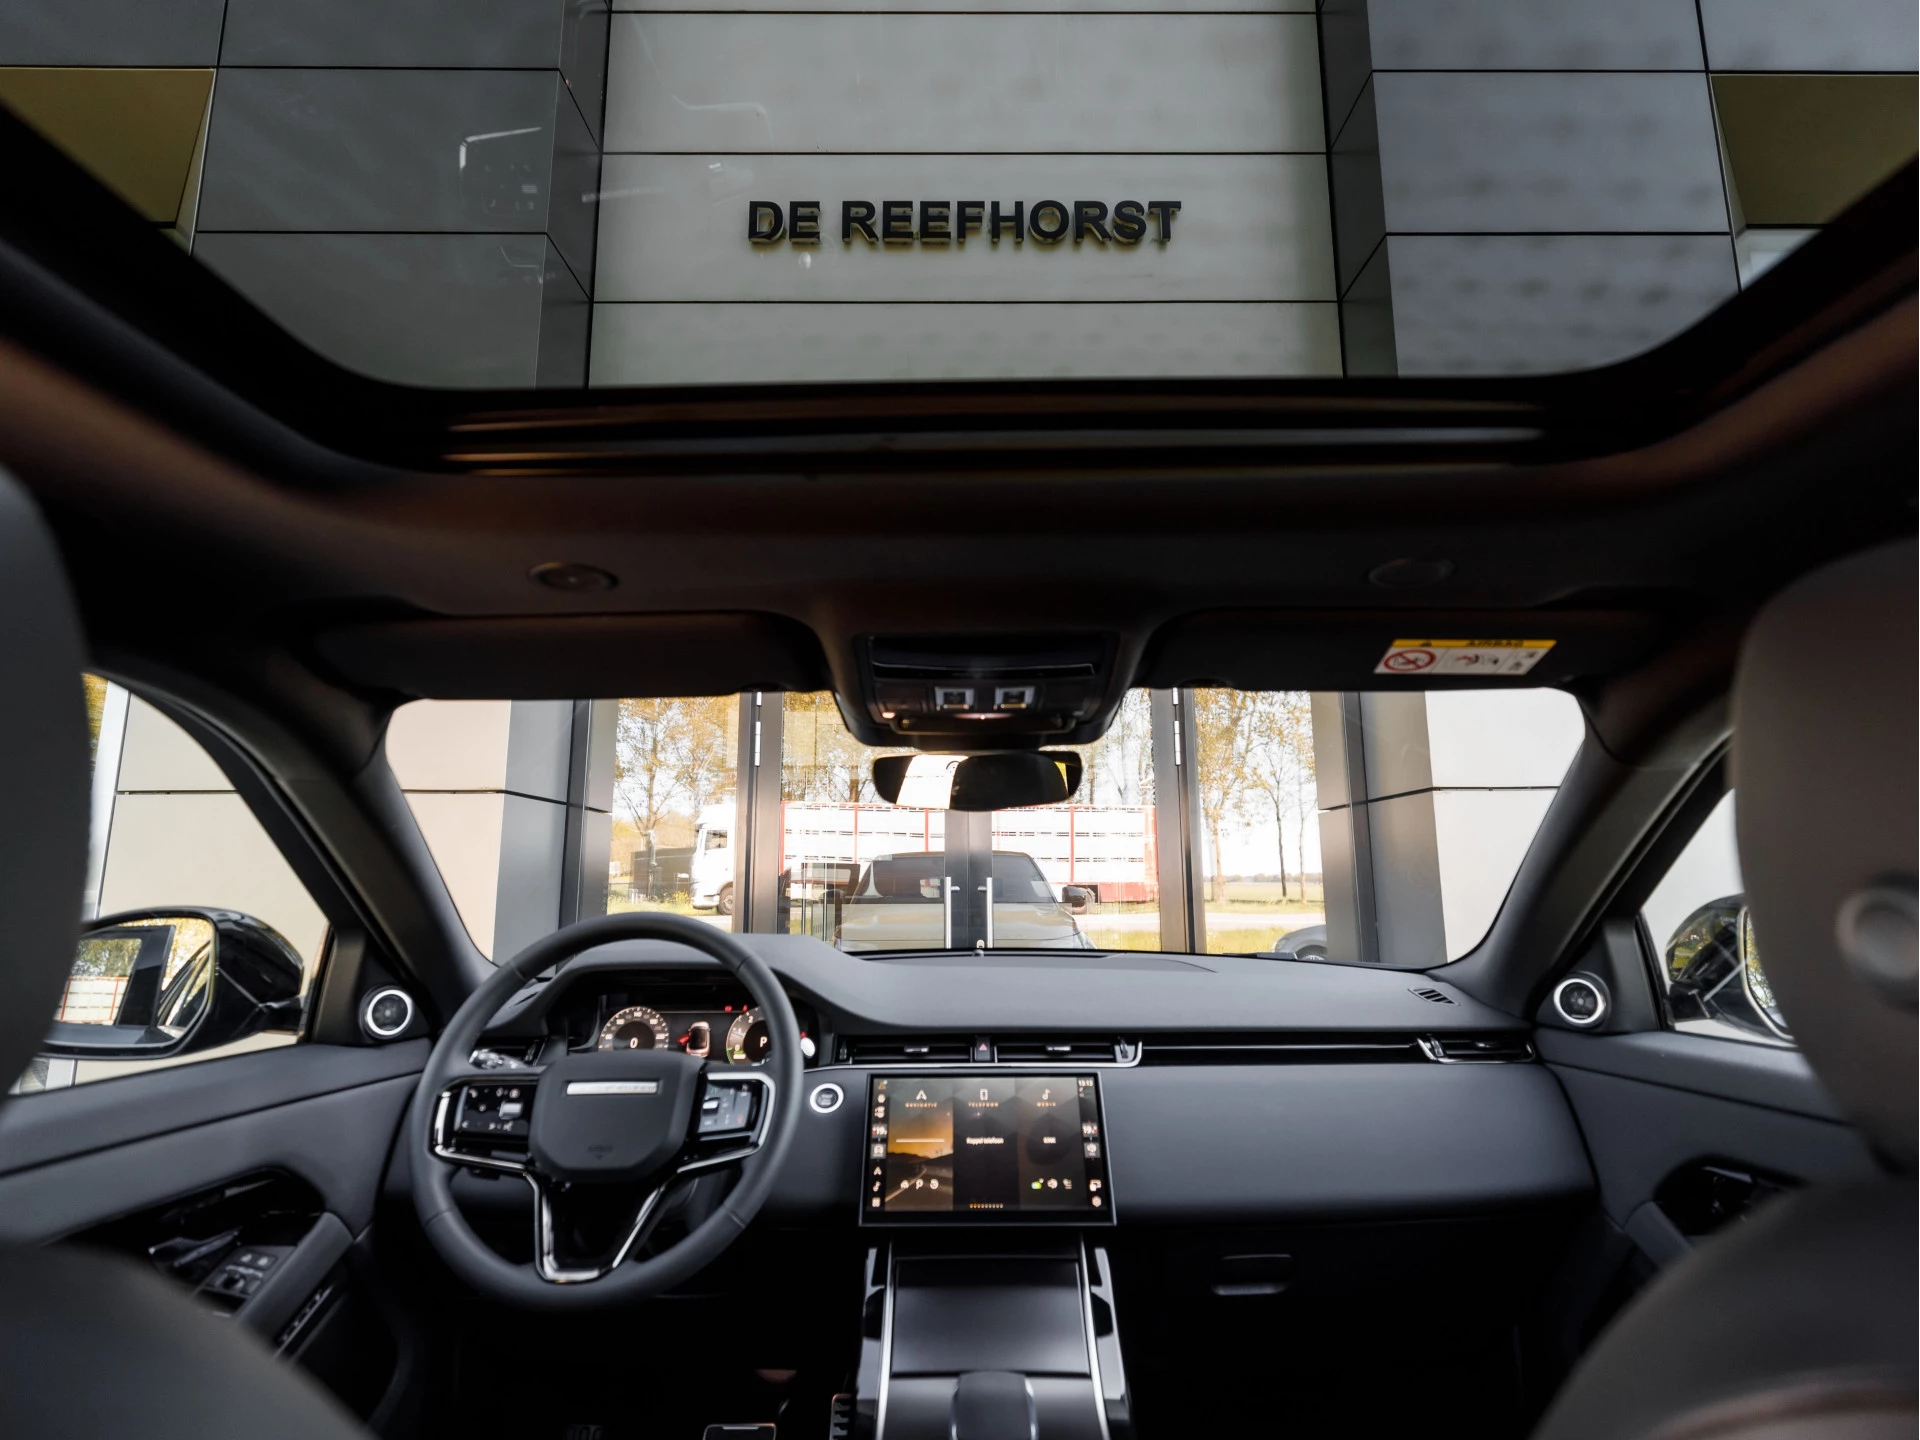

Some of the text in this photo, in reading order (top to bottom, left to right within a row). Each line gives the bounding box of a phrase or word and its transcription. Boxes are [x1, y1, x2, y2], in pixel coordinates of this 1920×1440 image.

[747, 200, 1182, 243] DE REEFHORST
[630, 1037, 639, 1049] 0
[760, 1036, 768, 1048] P
